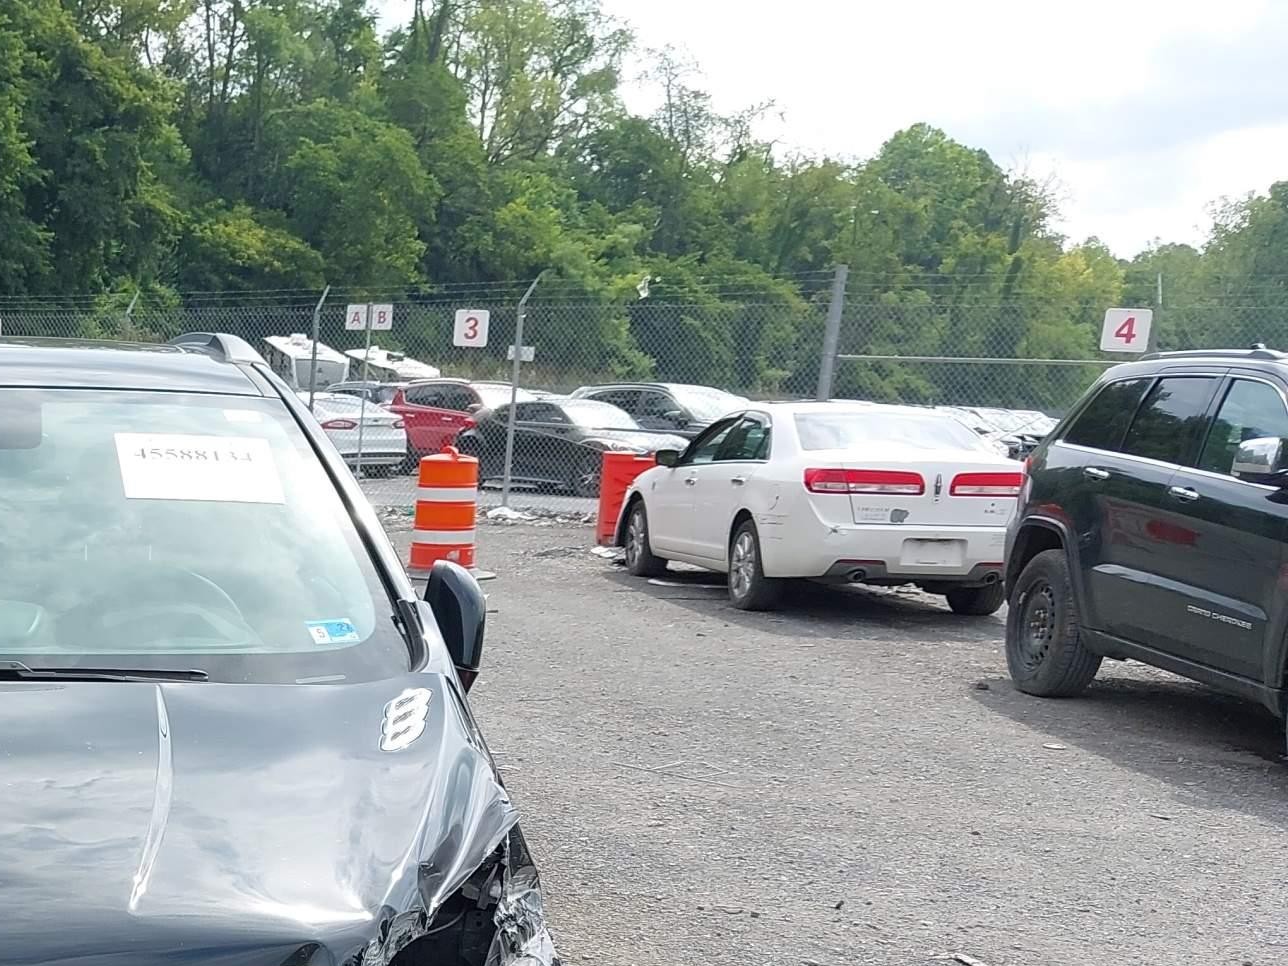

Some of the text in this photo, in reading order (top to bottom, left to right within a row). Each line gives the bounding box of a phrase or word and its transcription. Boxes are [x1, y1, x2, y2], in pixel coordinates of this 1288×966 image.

[351, 312, 361, 324] A
[377, 311, 387, 324] B
[463, 317, 479, 340] 3
[1114, 317, 1136, 344] 4
